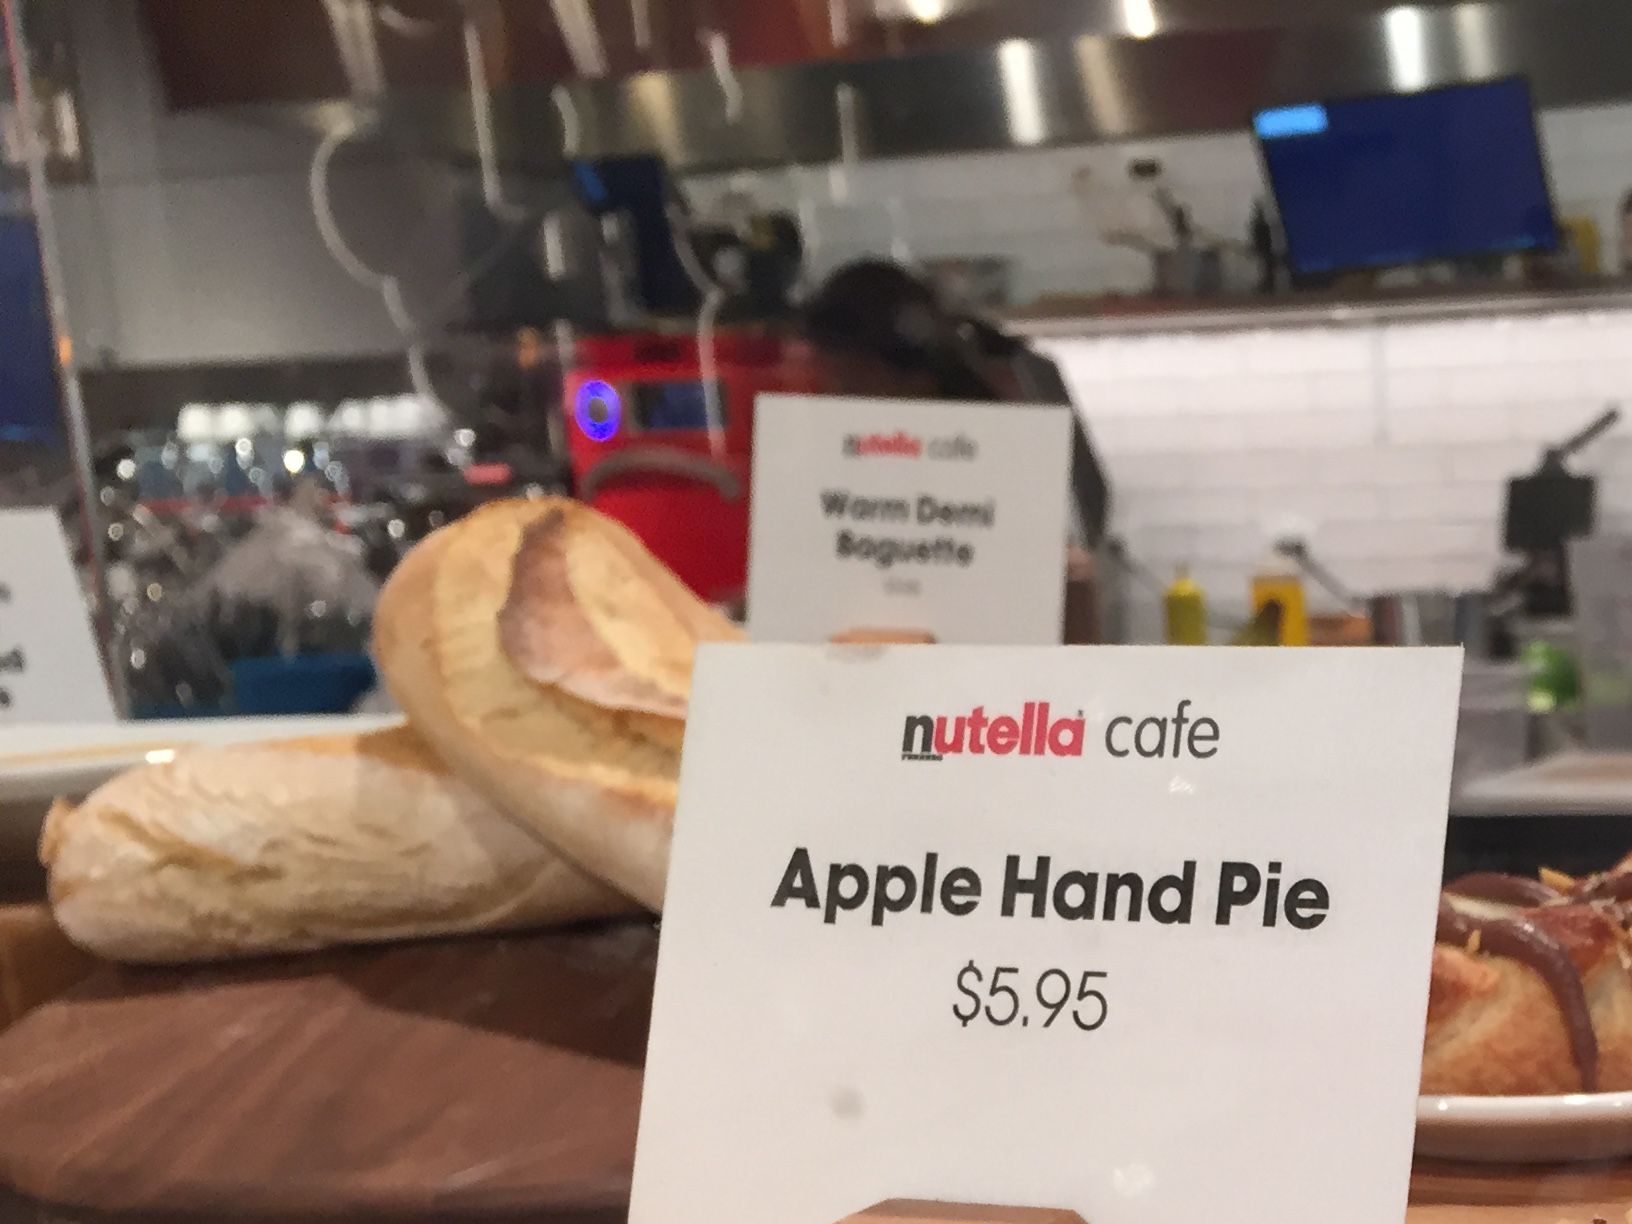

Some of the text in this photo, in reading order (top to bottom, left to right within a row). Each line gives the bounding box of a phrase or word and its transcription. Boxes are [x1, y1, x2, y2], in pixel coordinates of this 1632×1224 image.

[821, 490, 995, 528] Warm Demi
[836, 530, 973, 568] Baguette
[901, 700, 1220, 760] nutella cafe
[770, 847, 1330, 929] Apple Hand Pie
[953, 960, 1108, 1031] $5.95
